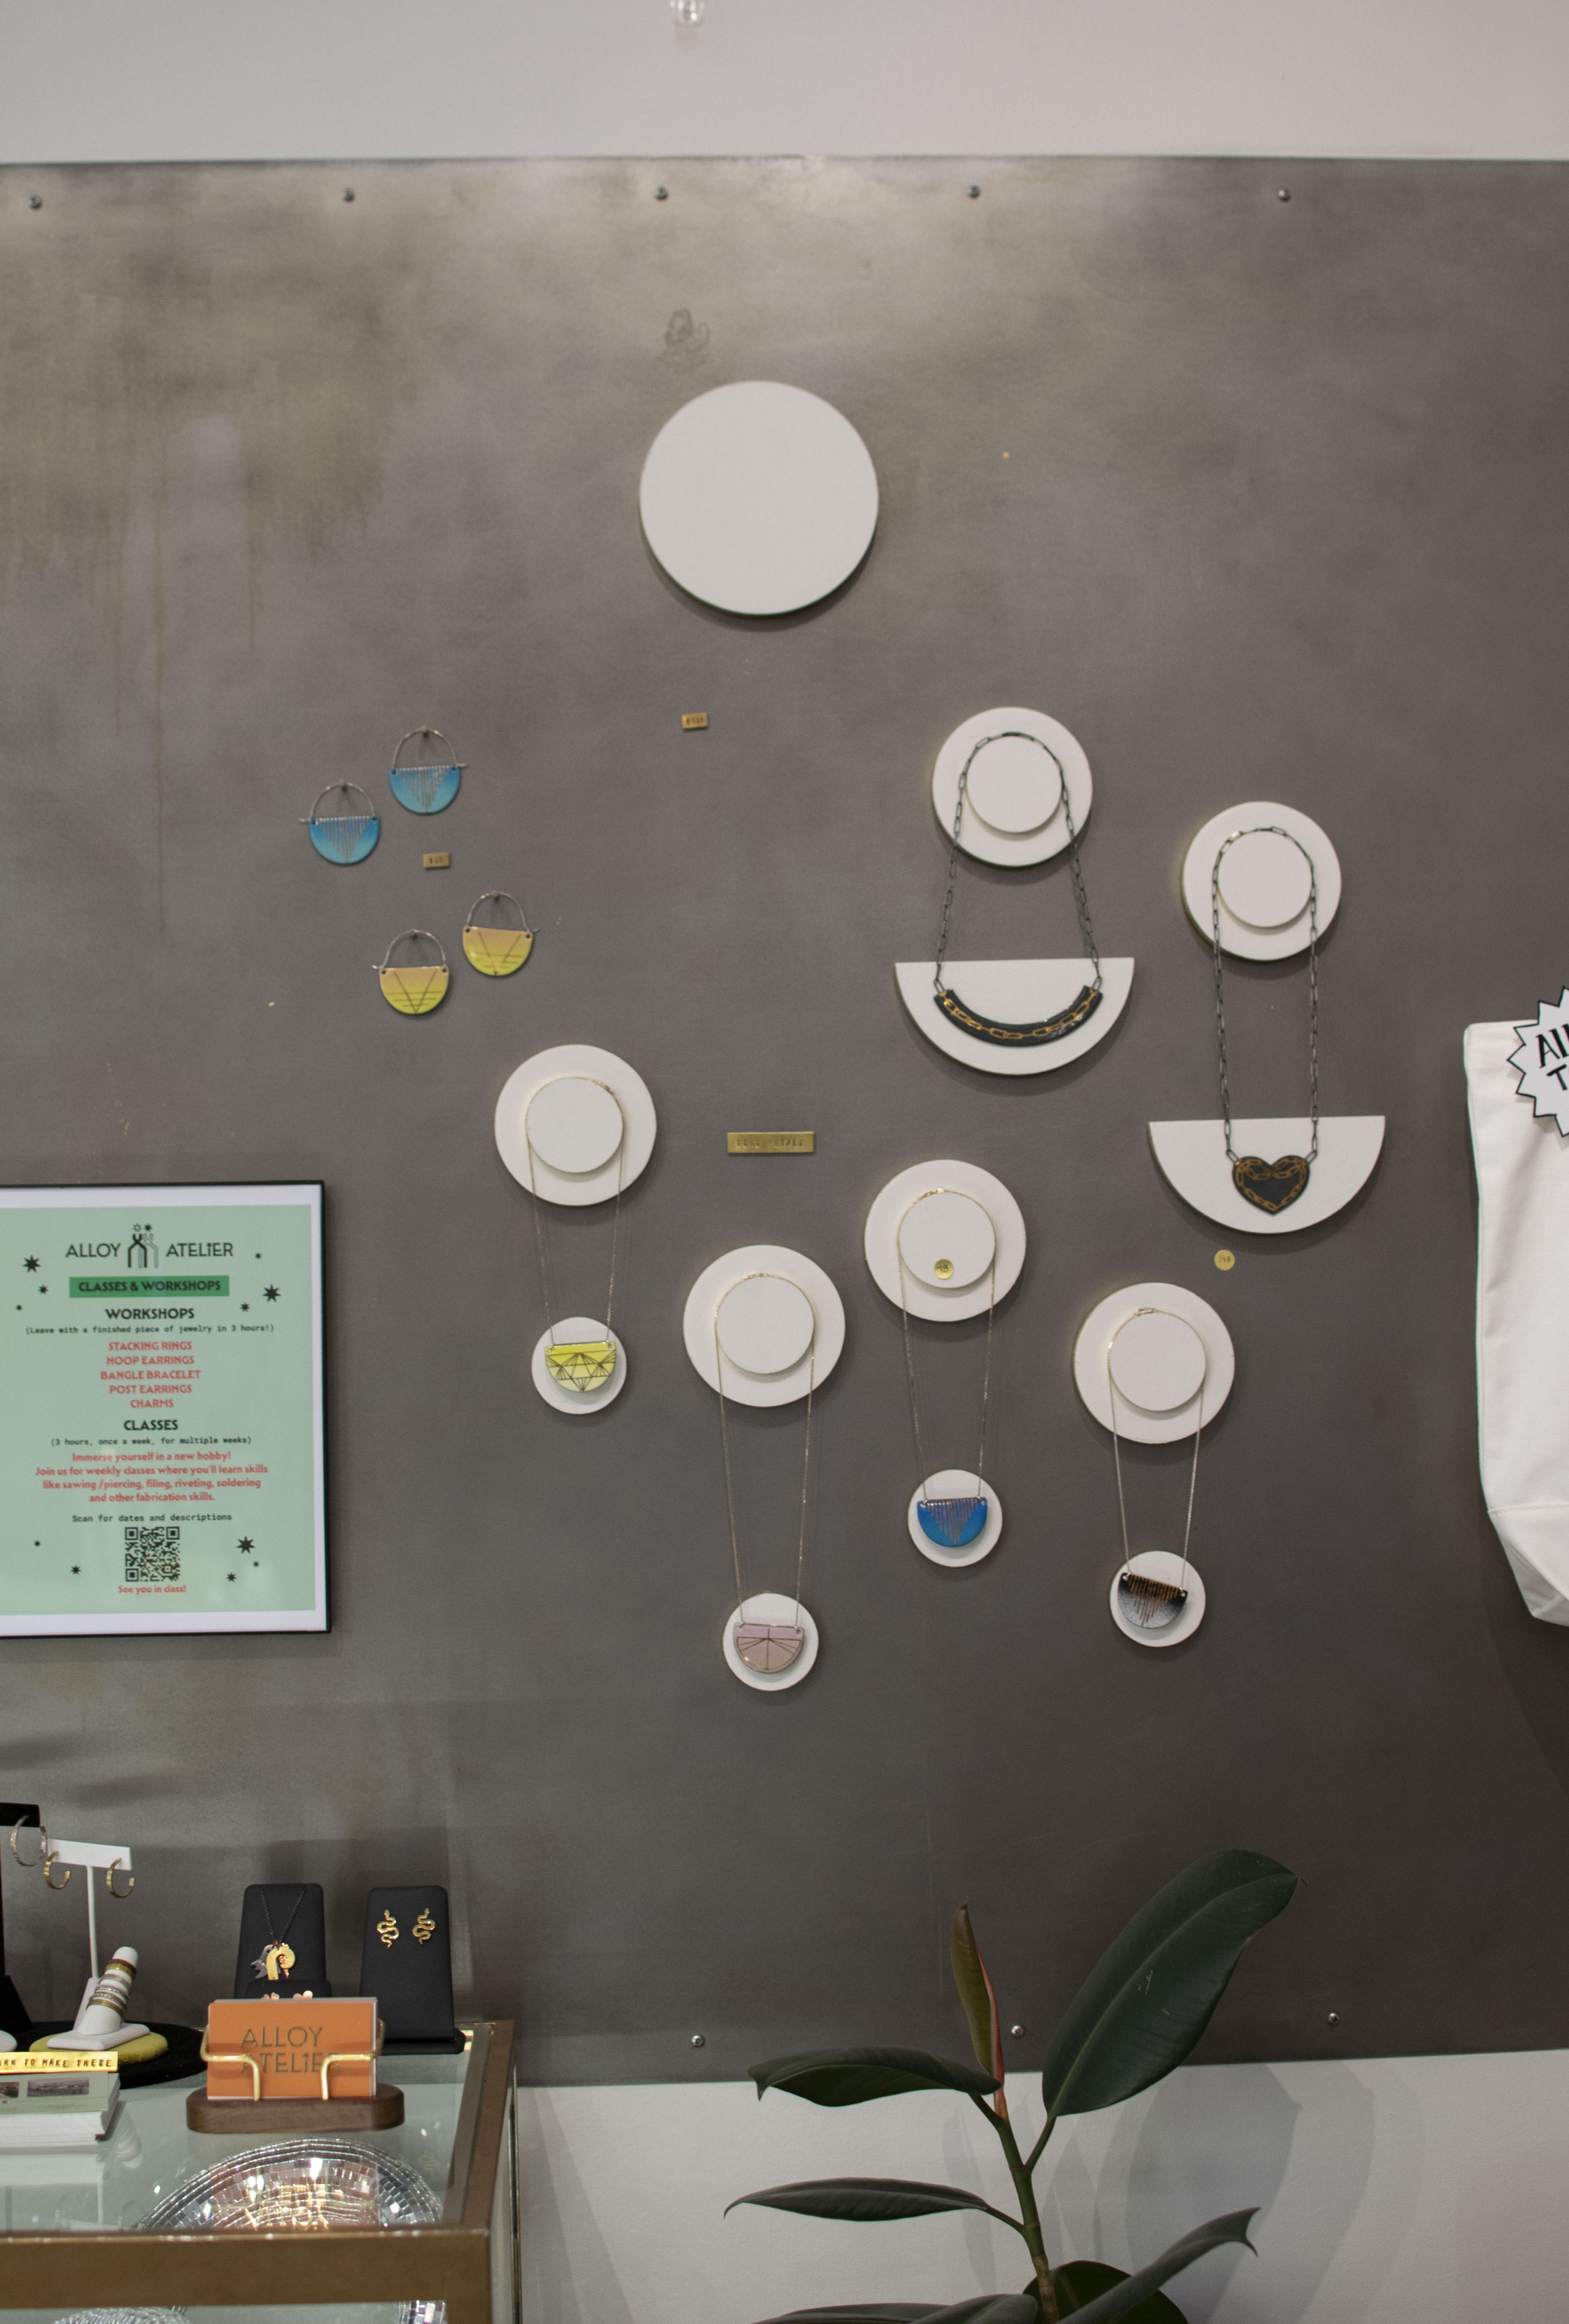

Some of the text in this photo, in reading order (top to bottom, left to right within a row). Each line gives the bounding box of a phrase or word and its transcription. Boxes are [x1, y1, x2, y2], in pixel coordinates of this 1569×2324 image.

[1546, 1064, 1569, 1091] T
[65, 1243, 120, 1258] ALLOY
[78, 1280, 221, 1292] CLASSES & WORKSHOPS
[105, 1308, 195, 1319] WORKSHOPS
[179, 1325, 212, 1334] jewelry
[240, 1324, 274, 1332] hours!)
[109, 1341, 192, 1351] STACKING RINGS
[107, 1356, 194, 1365] HOOP EARRINGS
[100, 1370, 201, 1379] BANGLE BRACELET
[109, 1384, 192, 1394] POST EARRINGS
[131, 1399, 174, 1408] CHARMS
[124, 1420, 178, 1430] CLASSES
[51, 1438, 60, 1447] (3
[65, 1438, 93, 1447] hours,
[132, 1438, 155, 1446] week,
[179, 1437, 218, 1445] multiple
[72, 1453, 113, 1462] Immerse
[115, 1452, 154, 1463] yourself
[156, 1452, 164, 1460] in
[197, 1451, 231, 1462] hobby!
[35, 1467, 55, 1475] Join
[69, 1466, 83, 1475] for
[85, 1466, 121, 1477] weekly
[123, 1466, 155, 1475] classes
[158, 1465, 188, 1474] where
[190, 1465, 217, 1476] you'll
[218, 1465, 243, 1474] learn
[245, 1464, 268, 1474] skills
[43, 1480, 61, 1489] like
[62, 1480, 97, 1491] sawing
[146, 1479, 173, 1490] filing,
[174, 1479, 214, 1490] riveting,
[217, 1478, 261, 1489] soldering
[89, 1492, 215, 1502] and other fabrication skills.
[170, 1514, 232, 1522] descriptions
[240, 2026, 323, 2047] ALLOY
[42, 2059, 68, 2067] MAKE
